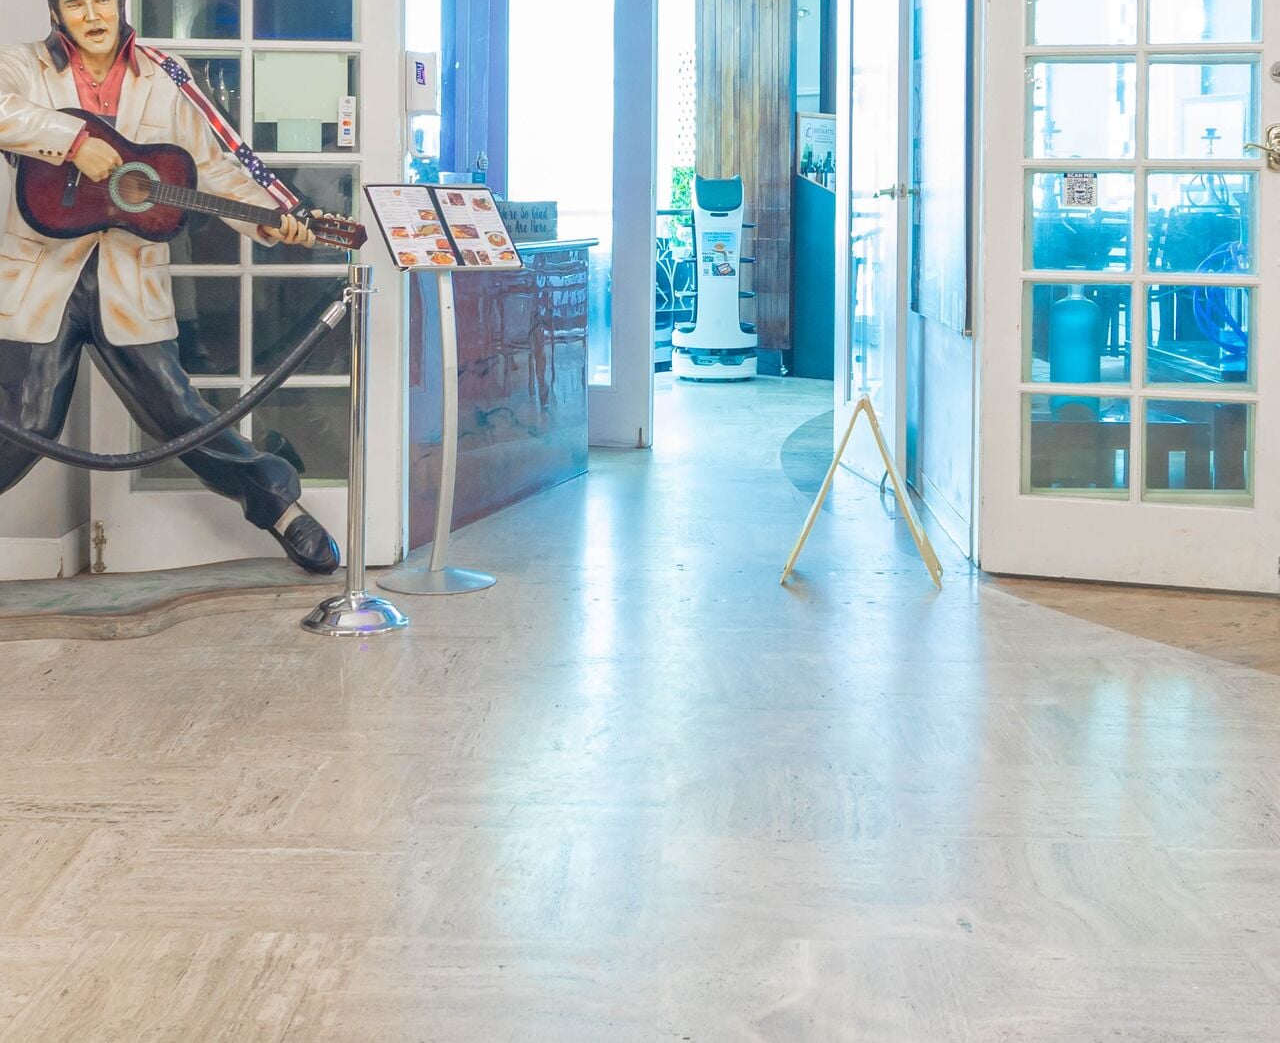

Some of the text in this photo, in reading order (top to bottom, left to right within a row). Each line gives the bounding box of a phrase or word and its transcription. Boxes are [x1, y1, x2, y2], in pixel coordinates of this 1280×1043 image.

[520, 205, 529, 220] So
[531, 205, 548, 221] Glad
[514, 219, 528, 234] Are
